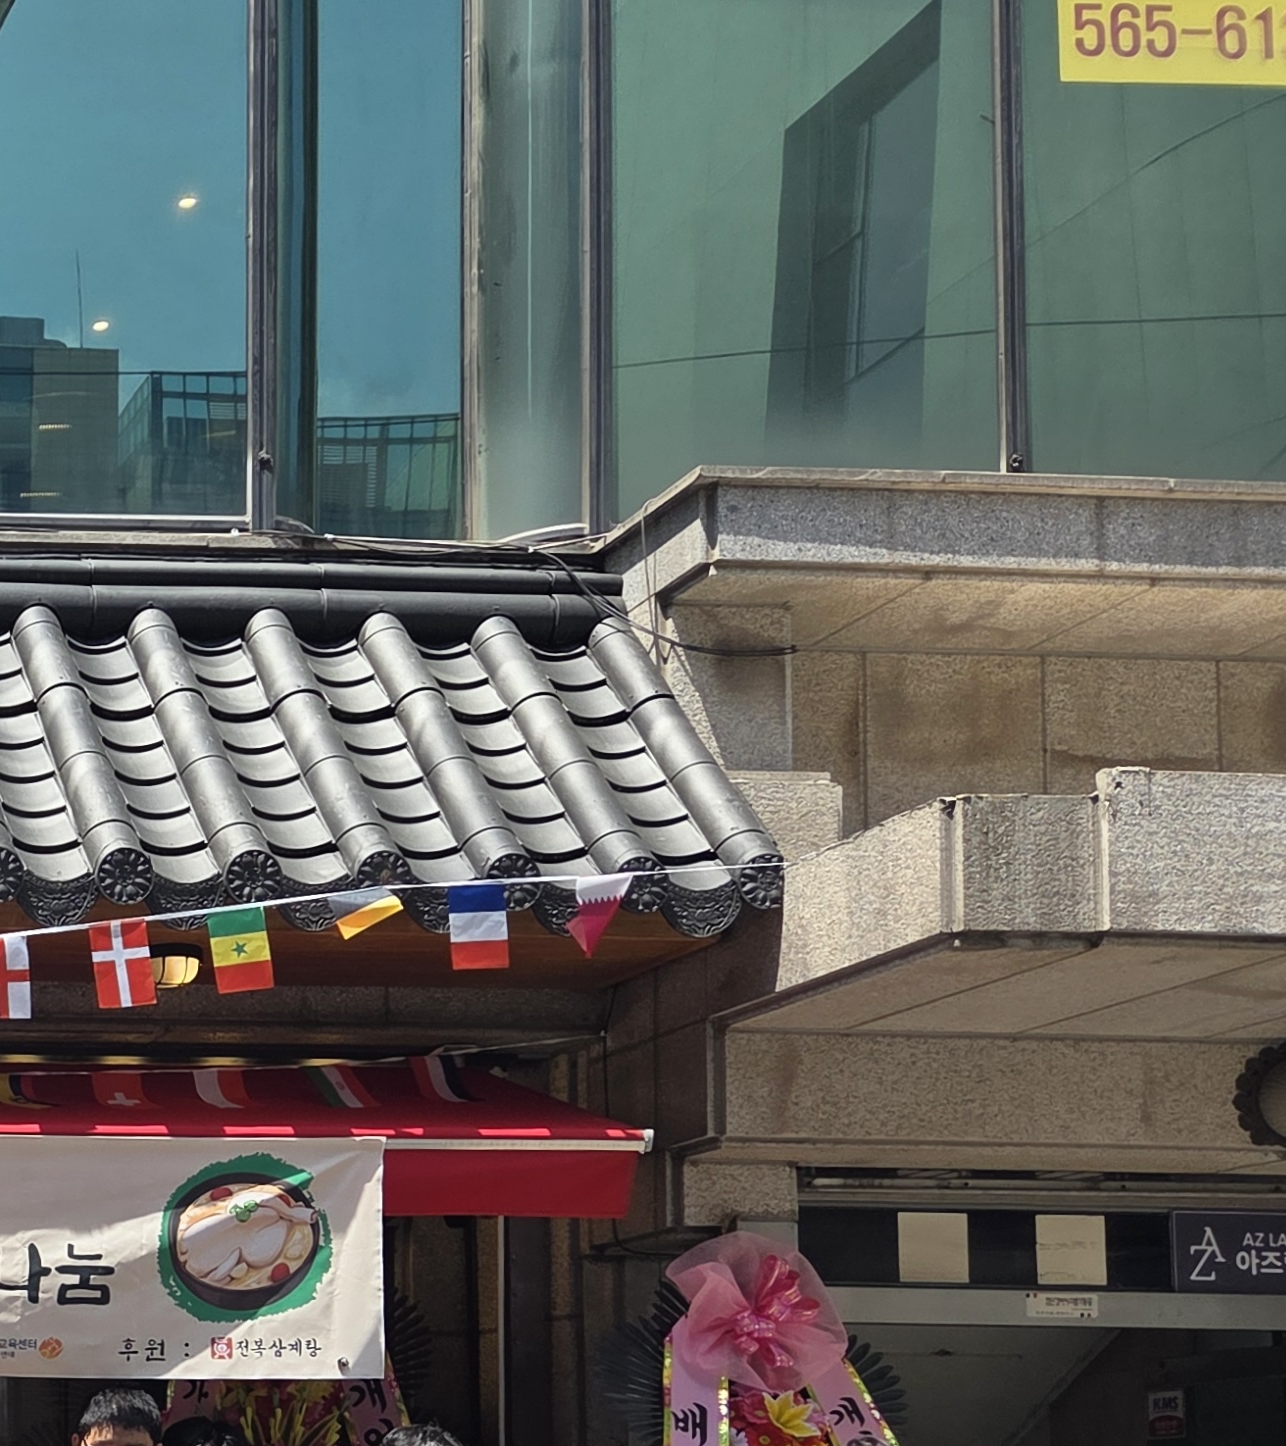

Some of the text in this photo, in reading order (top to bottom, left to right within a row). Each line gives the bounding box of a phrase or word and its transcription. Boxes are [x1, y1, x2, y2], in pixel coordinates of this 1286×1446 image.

[1073, 2, 1286, 61] 565-61
[1242, 1232, 1265, 1247] AZ
[1235, 1248, 1286, 1277] 아즈
[117, 1336, 167, 1362] 후원
[235, 1336, 323, 1359] 전복삼계탕
